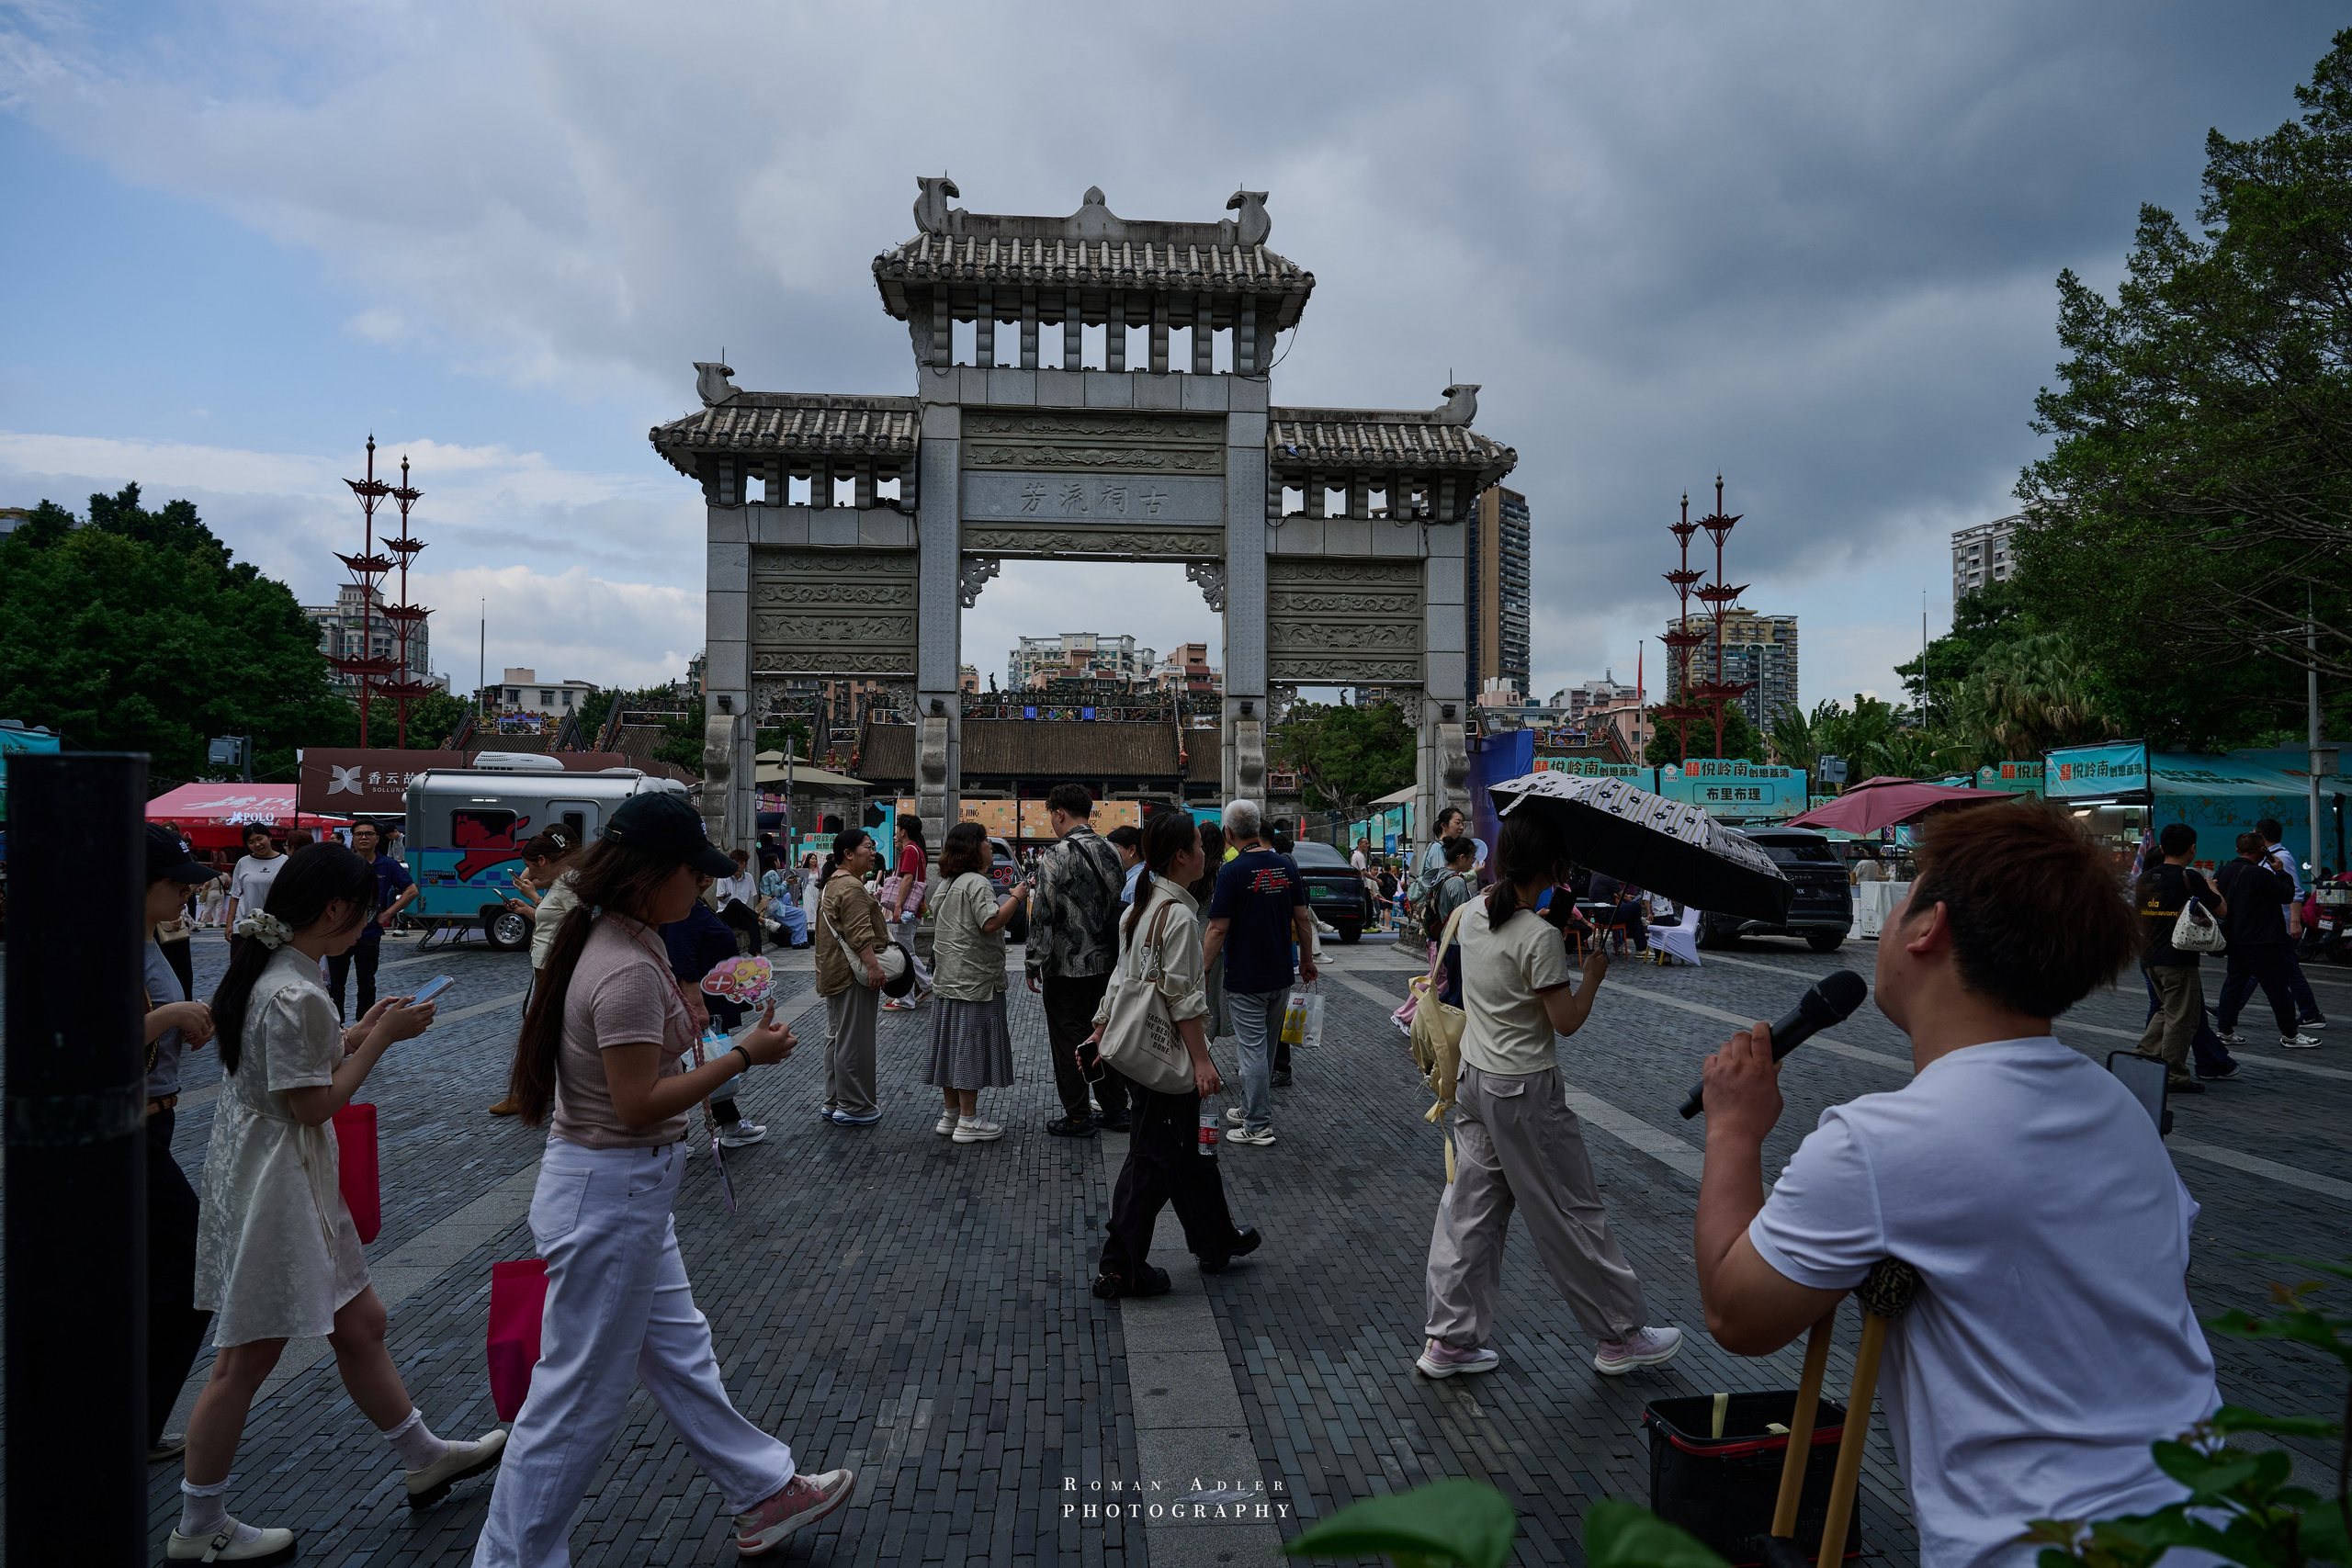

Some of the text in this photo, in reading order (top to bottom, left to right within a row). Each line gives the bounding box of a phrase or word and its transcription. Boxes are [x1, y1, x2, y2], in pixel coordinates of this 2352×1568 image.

[1706, 787, 1761, 801] 布里布理
[243, 812, 275, 822] POLO
[1091, 809, 1102, 818] ING
[1156, 1025, 1170, 1038] BEST
